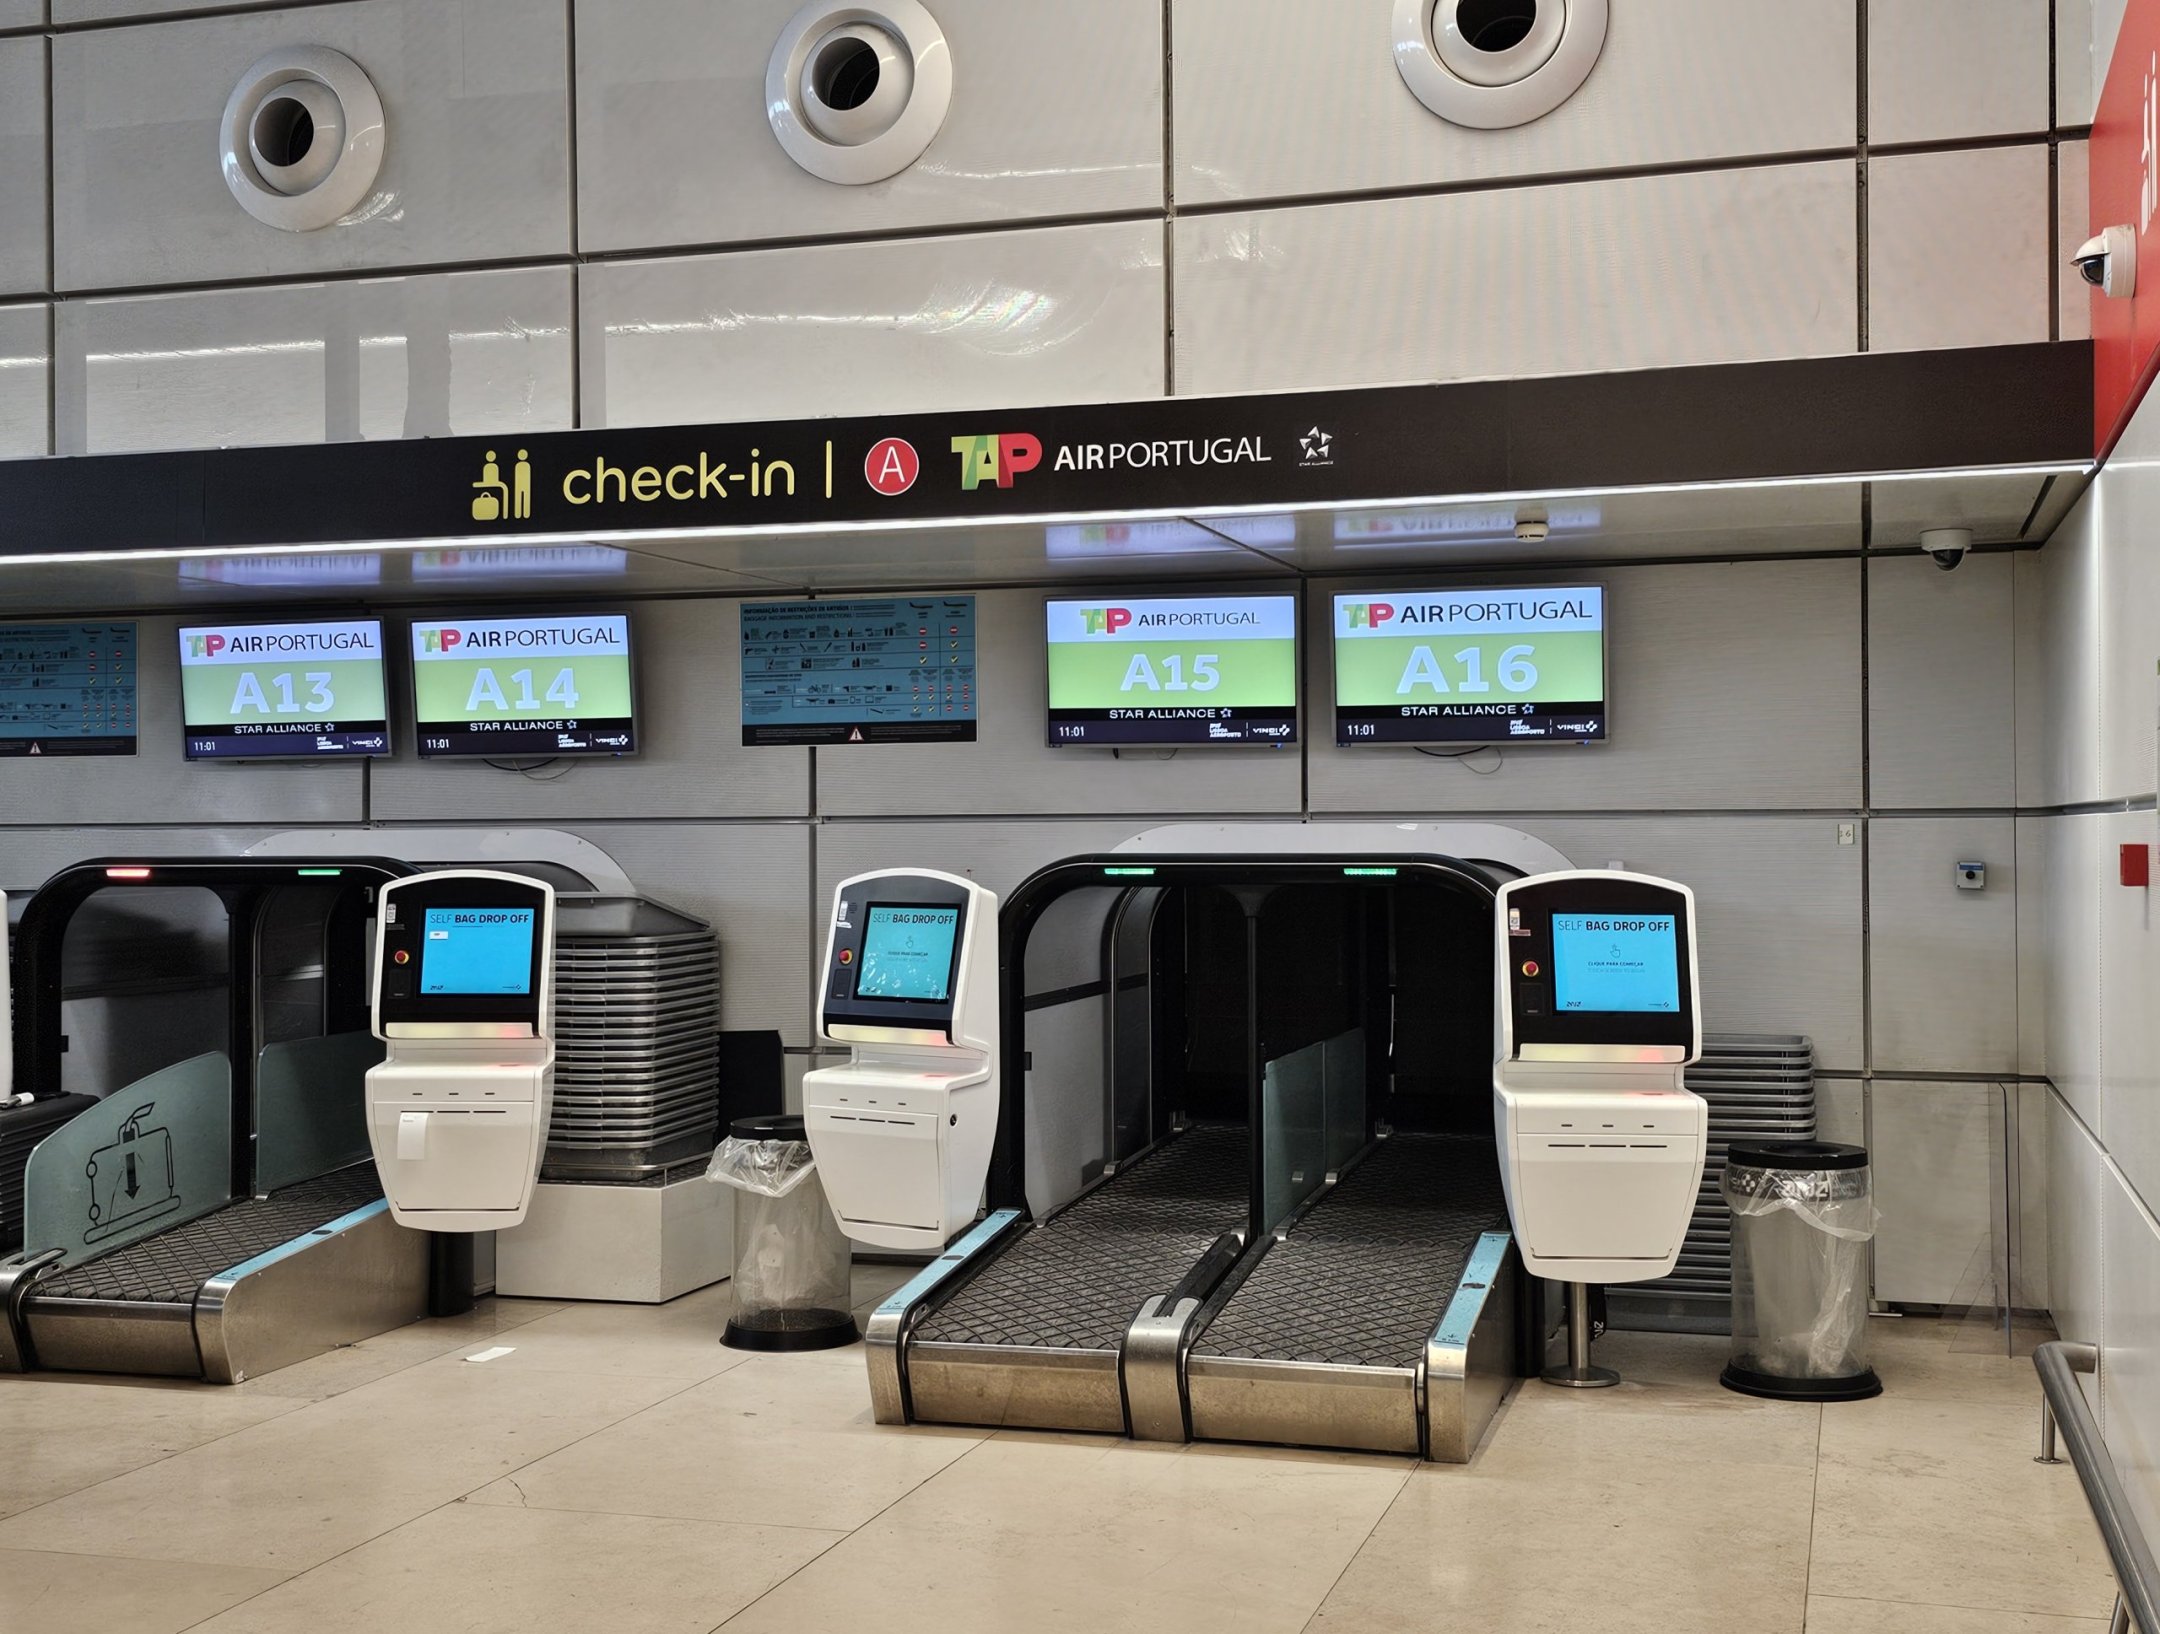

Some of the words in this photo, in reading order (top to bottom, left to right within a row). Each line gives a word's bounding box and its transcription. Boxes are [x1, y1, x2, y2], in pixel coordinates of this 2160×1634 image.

[878, 445, 907, 485] A
[950, 432, 1043, 491] TAP
[562, 448, 796, 504] check-in
[1080, 608, 1132, 635] TAP
[1343, 603, 1394, 628] TAP
[186, 635, 225, 657] TAP
[420, 629, 461, 652] TAP
[1120, 653, 1221, 692] A15
[1396, 644, 1539, 694] A16
[229, 671, 334, 715] A13
[464, 667, 580, 712] A14
[1109, 709, 1144, 720] STAR
[1148, 708, 1216, 719] ALLIANCE
[1401, 706, 1438, 717] STAR
[1442, 704, 1517, 716] ALLIANCE
[233, 725, 264, 735] STAR
[265, 723, 322, 734] ALLIANCE
[470, 722, 500, 732] STAR
[503, 720, 564, 732] ALLIANCE
[1058, 726, 1085, 738] 11:01
[1347, 724, 1376, 736] 11:01
[194, 741, 216, 752] 11:01
[426, 739, 450, 750] 11:01
[430, 913, 452, 924] SELF
[454, 914, 476, 924] BAG
[478, 914, 508, 924] DROP
[509, 914, 529, 924] OFF
[873, 913, 891, 923] SELF
[892, 913, 910, 924] BAG
[911, 913, 936, 924] DROP
[937, 915, 954, 925] OFF
[1558, 920, 1583, 931] SELF
[1585, 921, 1610, 931] BAG
[1613, 921, 1646, 932] DROP
[1647, 921, 1670, 932] OFF
